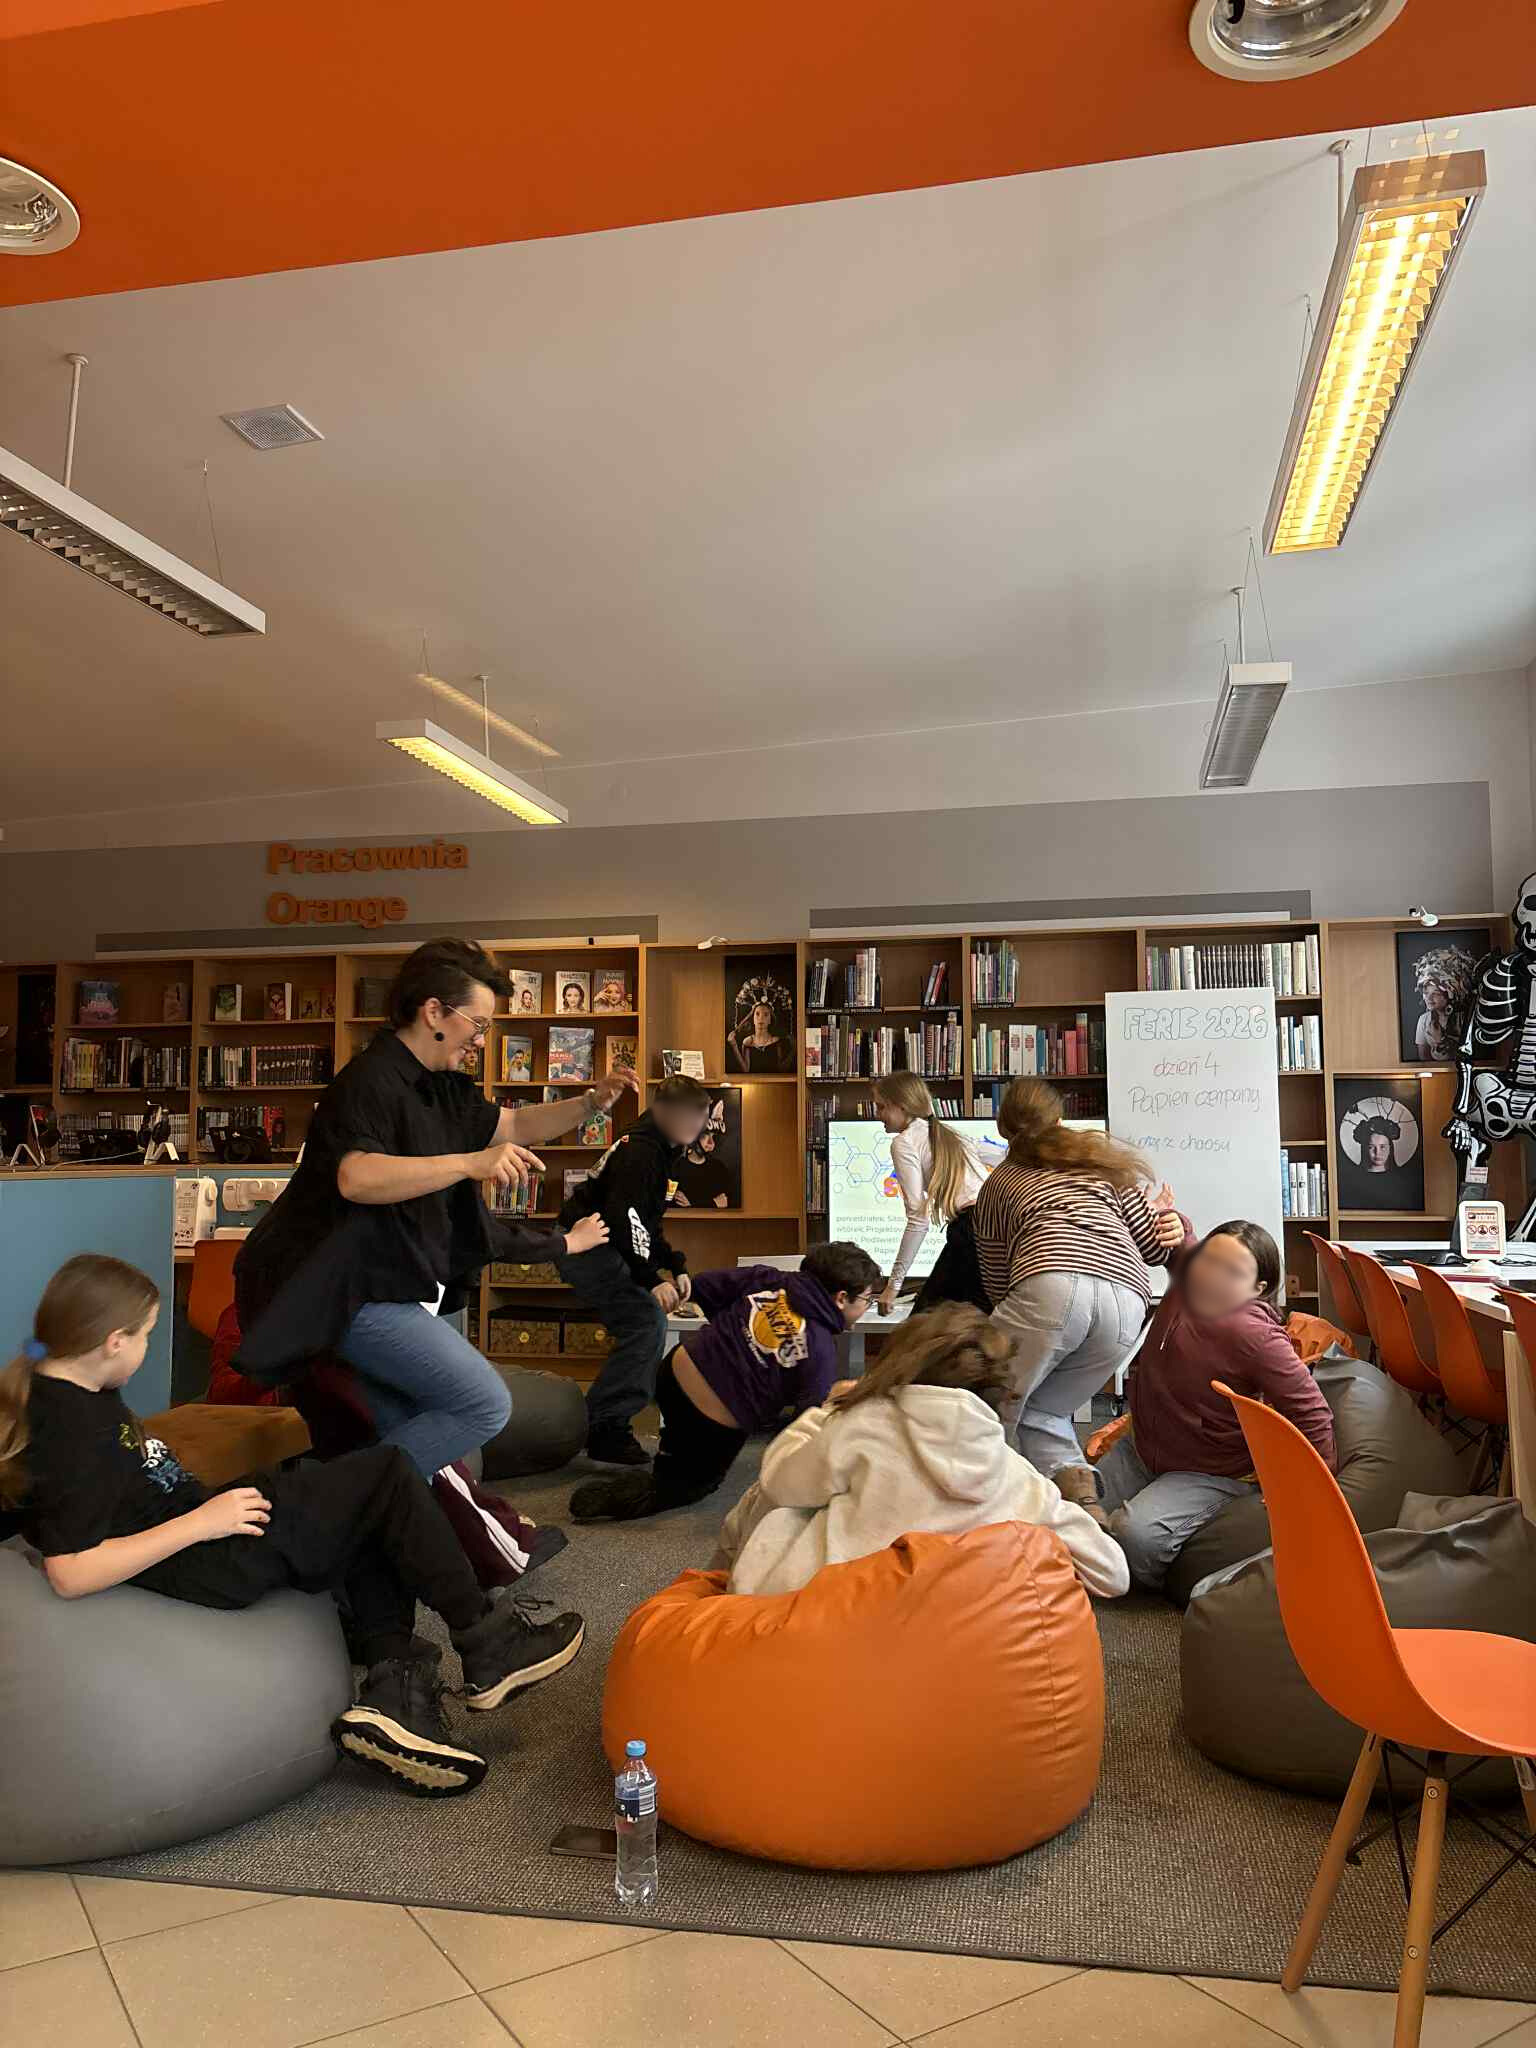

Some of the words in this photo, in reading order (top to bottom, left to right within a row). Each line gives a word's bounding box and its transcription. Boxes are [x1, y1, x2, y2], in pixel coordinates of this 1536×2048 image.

[268, 838, 469, 874] Pracownia
[267, 892, 408, 929] Orange
[1124, 1007, 1200, 1040] FERIE
[1203, 1005, 1268, 1040] 2026
[1204, 1051, 1221, 1076] 4
[1128, 1086, 1190, 1118] Papier
[1180, 1133, 1231, 1153] chaosu
